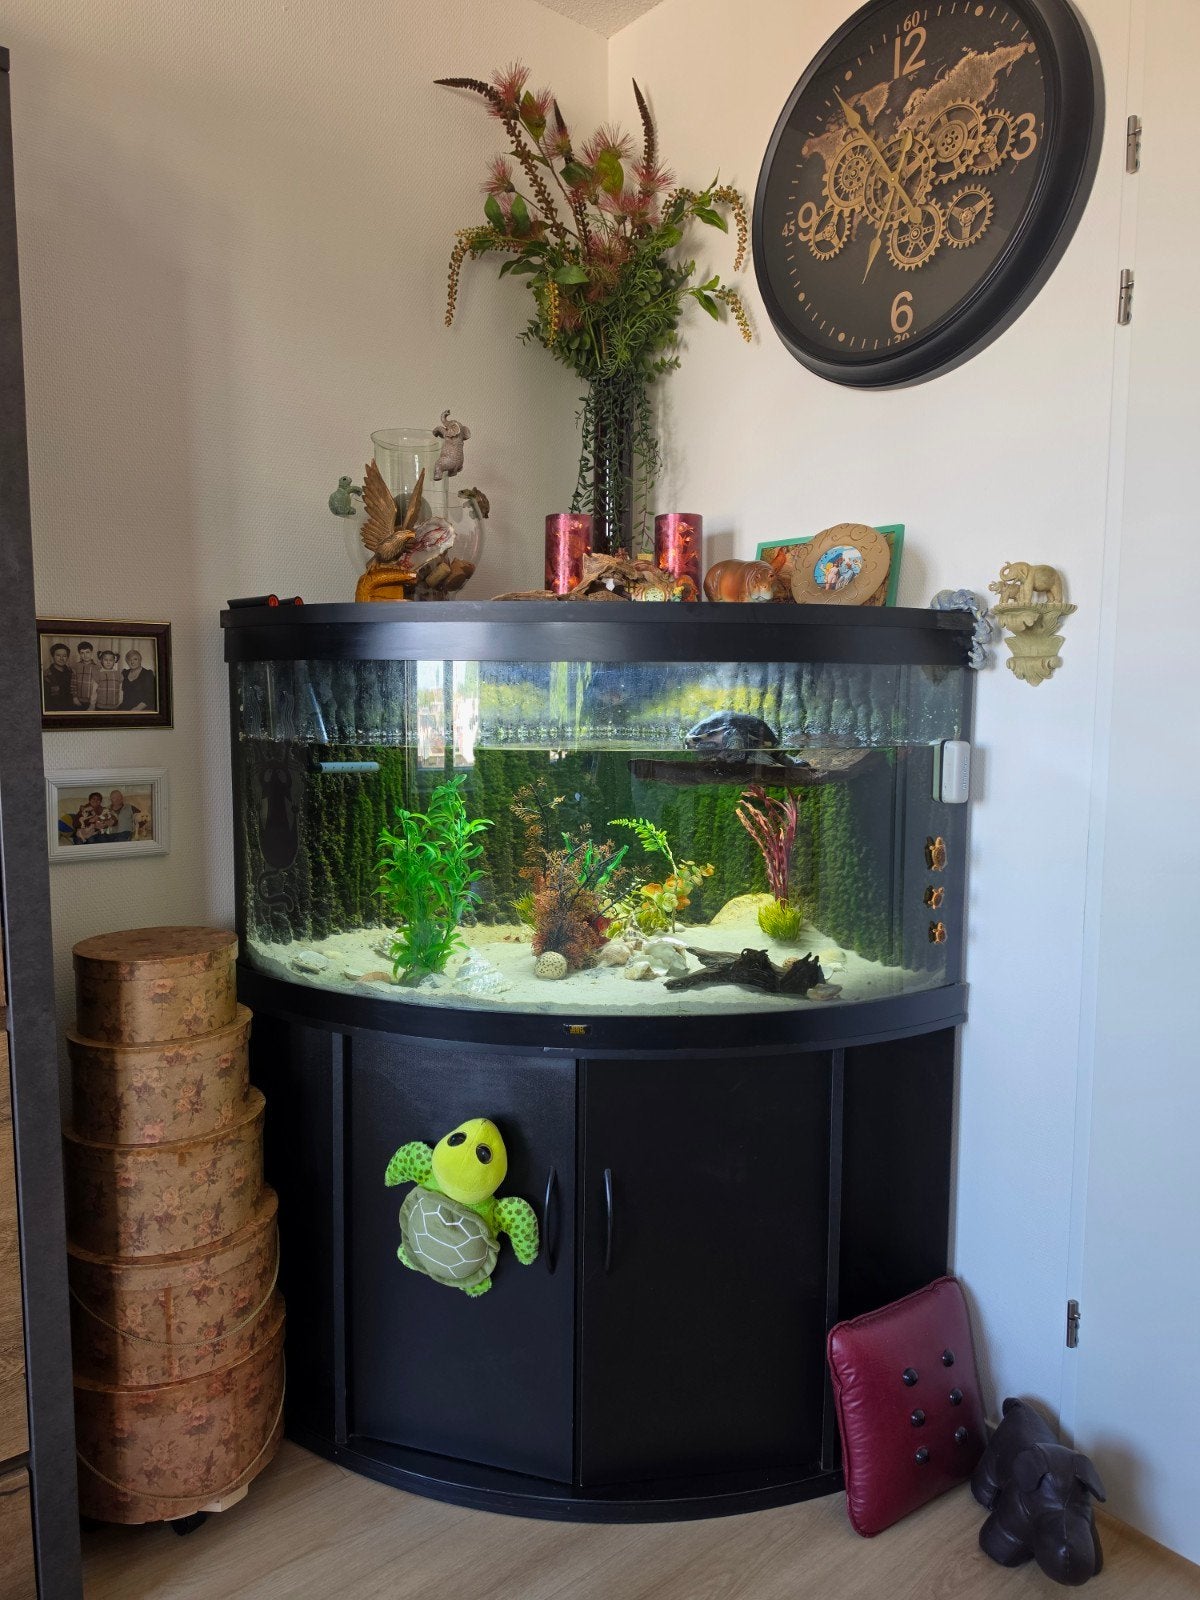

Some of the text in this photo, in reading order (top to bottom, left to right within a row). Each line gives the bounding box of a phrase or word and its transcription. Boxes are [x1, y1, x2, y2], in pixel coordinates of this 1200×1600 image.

[903, 10, 921, 32] 60
[893, 26, 927, 80] 12
[1010, 112, 1037, 161] 3
[781, 219, 796, 238] 45
[798, 201, 820, 242] 9
[890, 290, 914, 334] 6
